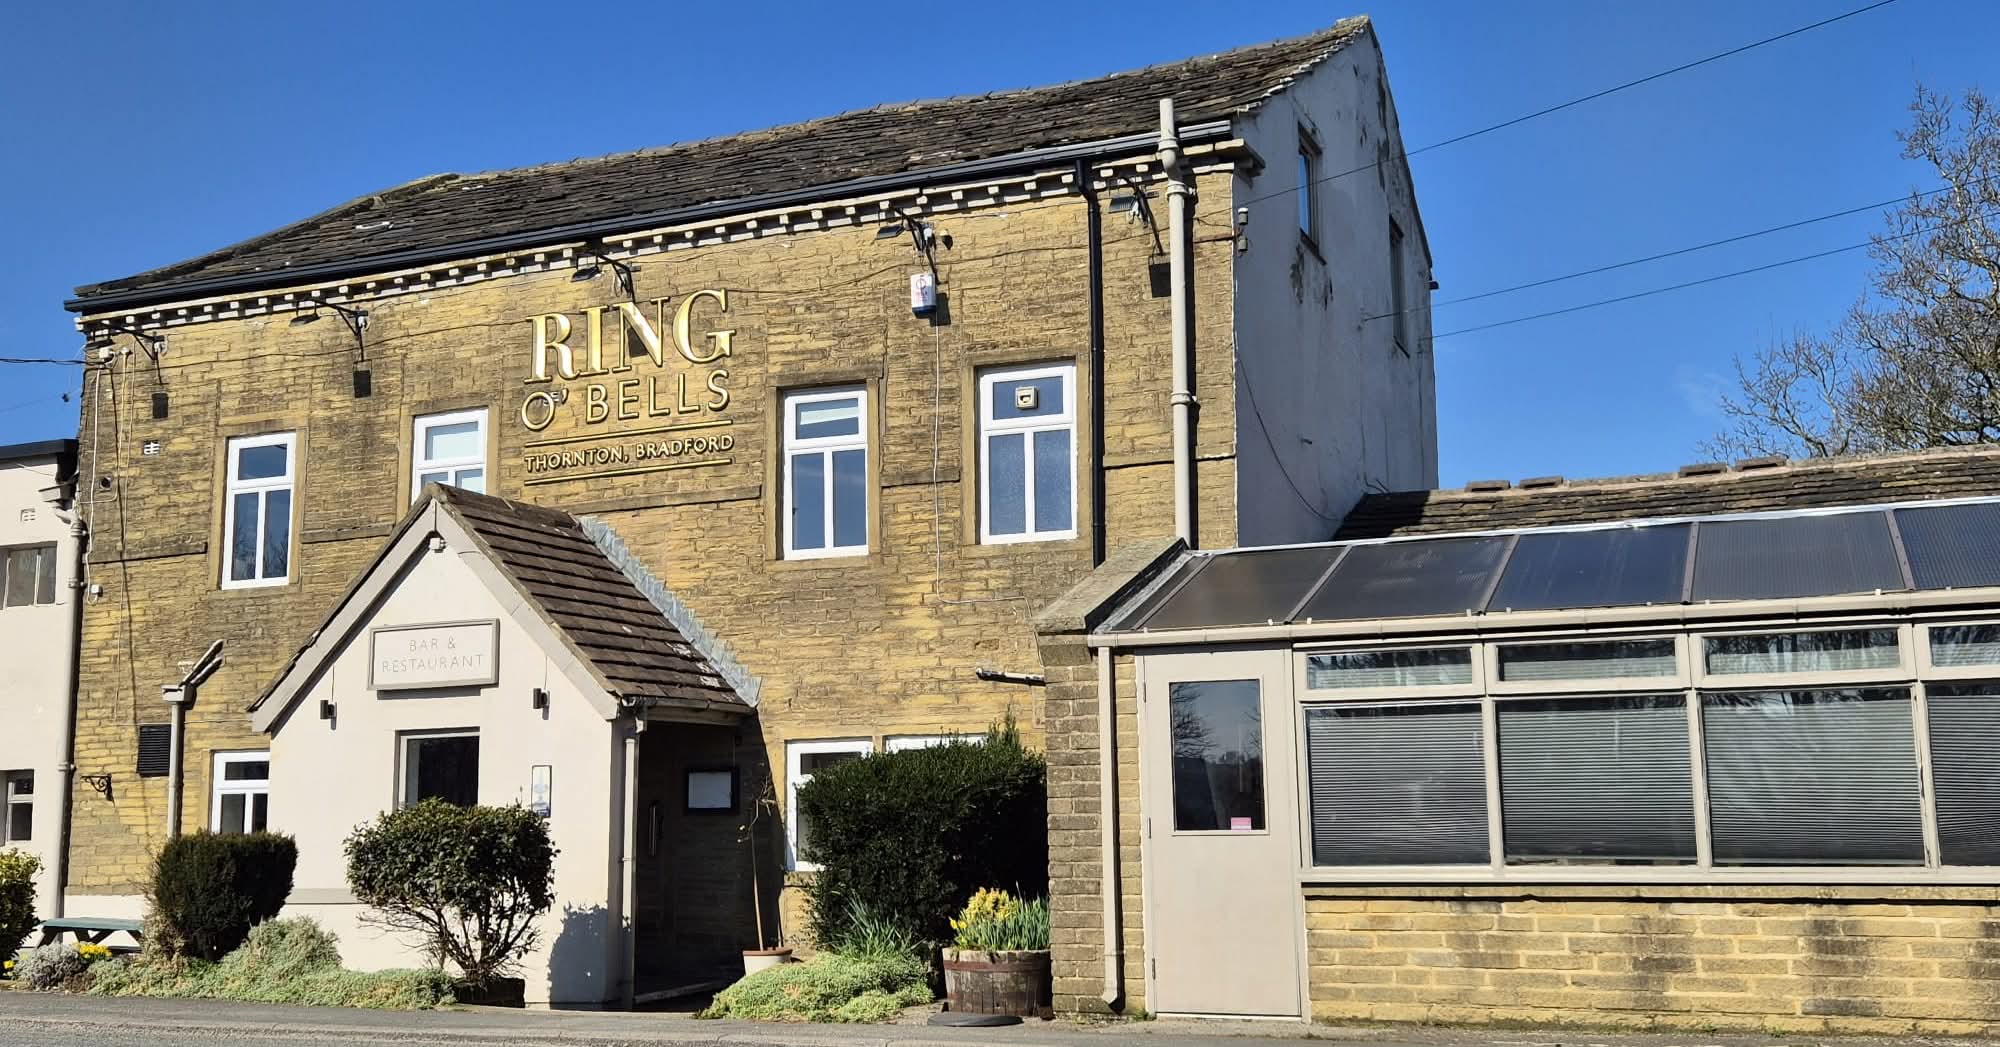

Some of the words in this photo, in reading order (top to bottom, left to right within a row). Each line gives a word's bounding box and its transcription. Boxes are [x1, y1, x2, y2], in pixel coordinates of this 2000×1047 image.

[523, 288, 737, 384] RING
[521, 387, 569, 430] O'
[586, 369, 729, 424] BELLS
[524, 445, 629, 473] THORNTON,
[636, 434, 735, 459] BRADFORD
[409, 637, 438, 652] BAR
[447, 635, 456, 649] &
[382, 654, 483, 673] RESTAURANT
